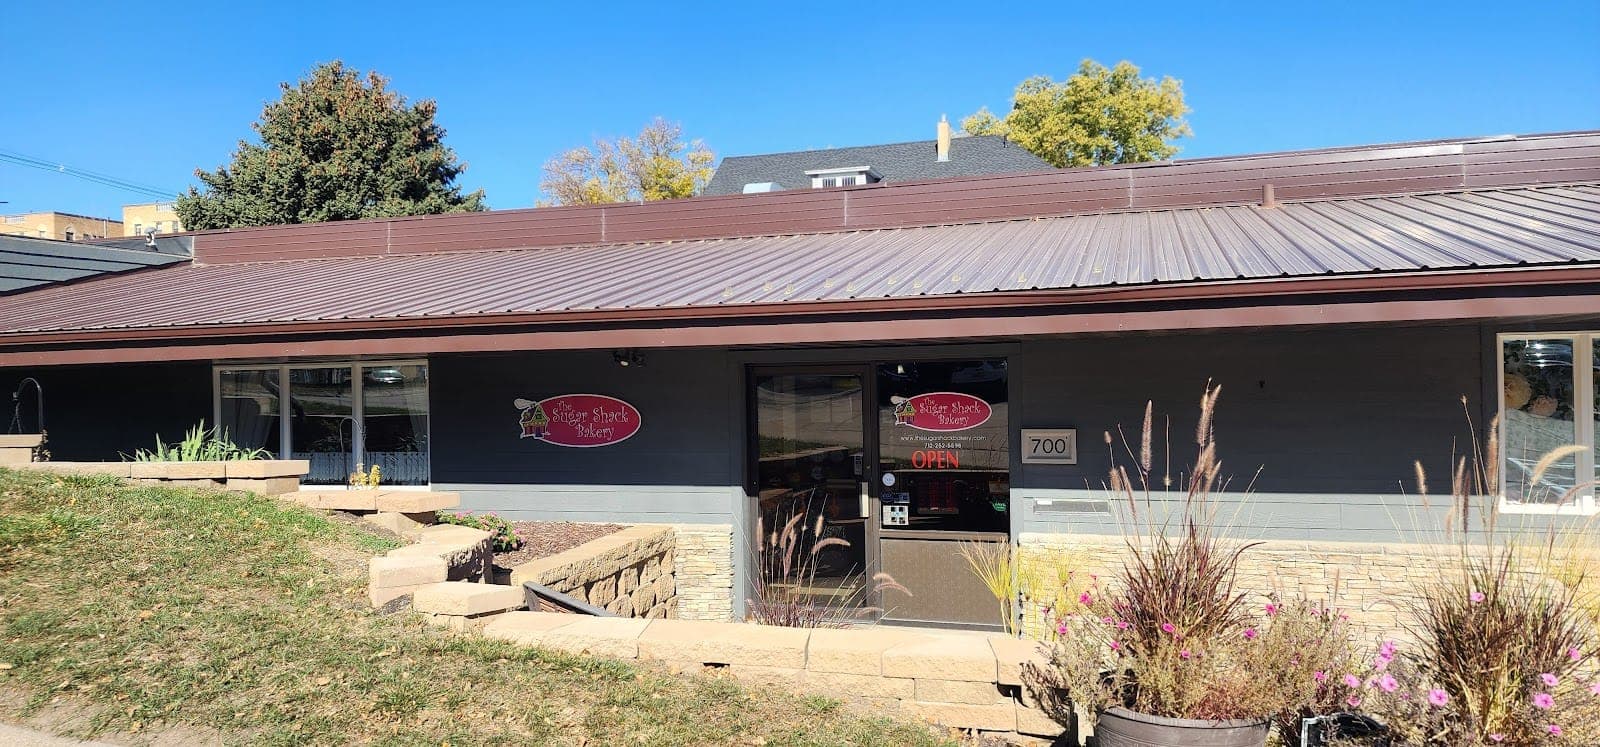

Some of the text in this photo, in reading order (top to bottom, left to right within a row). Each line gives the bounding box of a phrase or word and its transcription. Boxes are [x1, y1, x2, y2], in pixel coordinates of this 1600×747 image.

[557, 401, 573, 411] The
[920, 401, 981, 416] Sugar Shack
[924, 397, 936, 406] The
[552, 406, 629, 426] Sugar Shack
[937, 413, 969, 426] Bakery
[576, 423, 616, 440] Bakery
[1031, 438, 1066, 454] 700
[911, 450, 960, 469] OPEN
